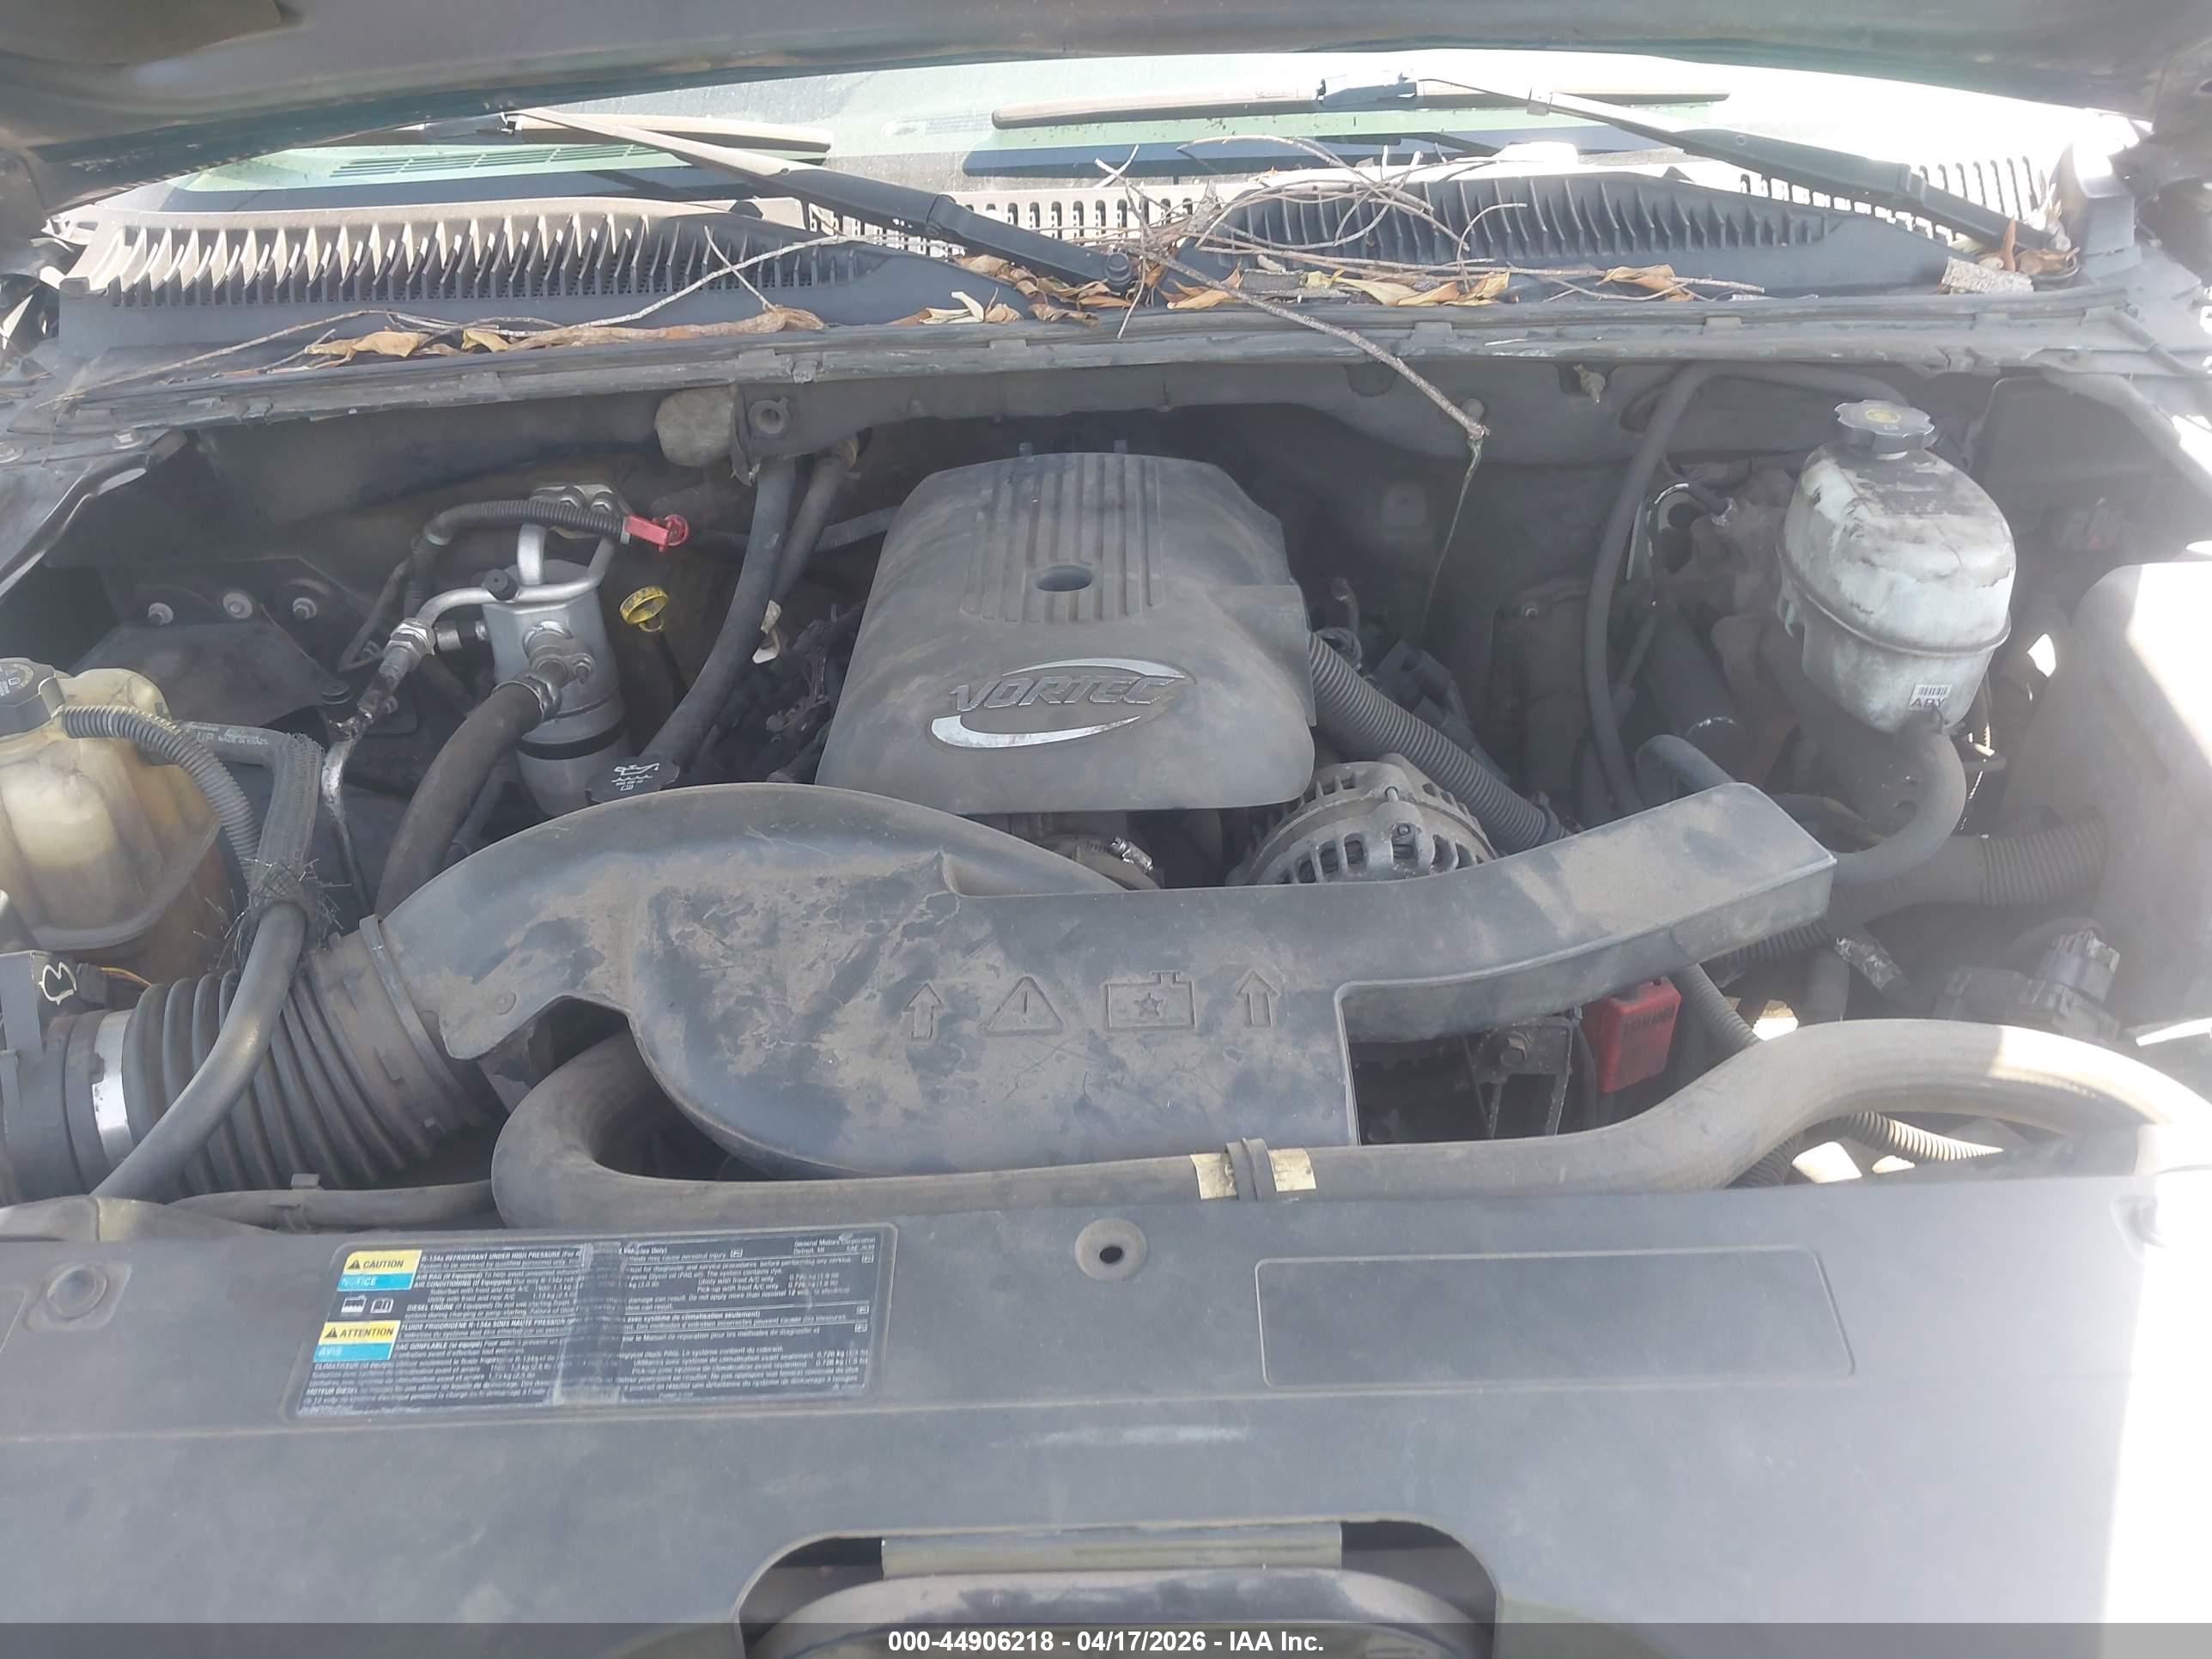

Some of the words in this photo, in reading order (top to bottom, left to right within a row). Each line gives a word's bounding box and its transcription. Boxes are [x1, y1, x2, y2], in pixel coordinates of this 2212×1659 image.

[950, 675, 1174, 712] VORTEC
[794, 1239, 817, 1248] General
[818, 1237, 841, 1246] Motors
[445, 1252, 488, 1261] REFRIGERANT
[489, 1251, 511, 1260] UNDER
[528, 1250, 561, 1259] PRESSURE
[362, 1259, 404, 1269] CAUTION
[426, 1279, 471, 1288] CONDITIONING
[406, 1303, 429, 1311] DIESEL
[429, 1302, 454, 1310] ENGINE
[724, 1310, 761, 1319] seulement)
[511, 1318, 534, 1327] HAUTE
[534, 1317, 567, 1327] PRESSION
[339, 1328, 395, 1338] ATTENTION
[318, 1346, 343, 1357] AVIS
[306, 1388, 335, 1396] MOTEUR
